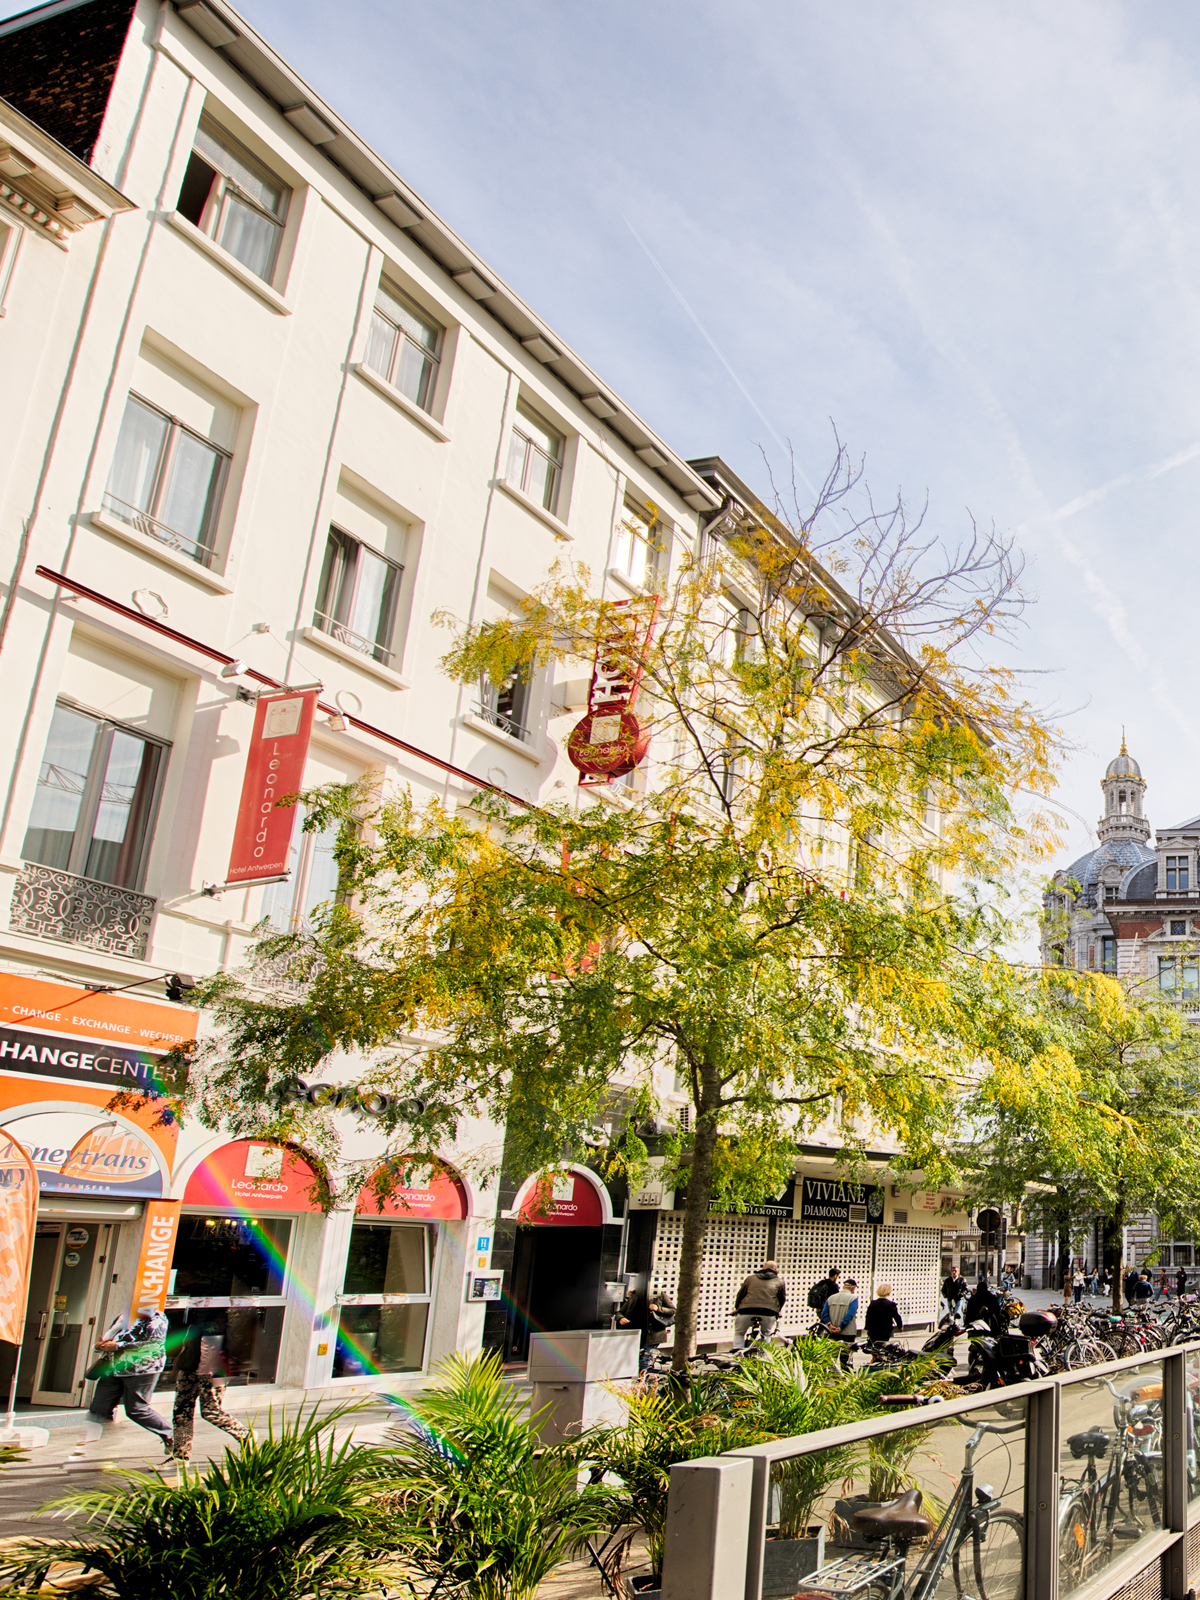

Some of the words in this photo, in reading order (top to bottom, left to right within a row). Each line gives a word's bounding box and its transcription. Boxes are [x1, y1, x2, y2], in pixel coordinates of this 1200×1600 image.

[253, 742, 281, 858] Leonardo
[229, 865, 247, 875] Hotel
[247, 862, 283, 872] Antwerpen
[12, 1005, 61, 1022] CHANGE
[72, 1016, 131, 1034] EXCHANGE
[58, 1183, 110, 1192] TRANSFER
[231, 1178, 288, 1193] Leonardo
[806, 1180, 866, 1204] VIVIANE
[234, 1190, 250, 1198] Hotel
[251, 1192, 283, 1200] Antwerpen
[744, 1206, 787, 1217] DIAMONDS
[804, 1204, 848, 1218] DIAMONDS
